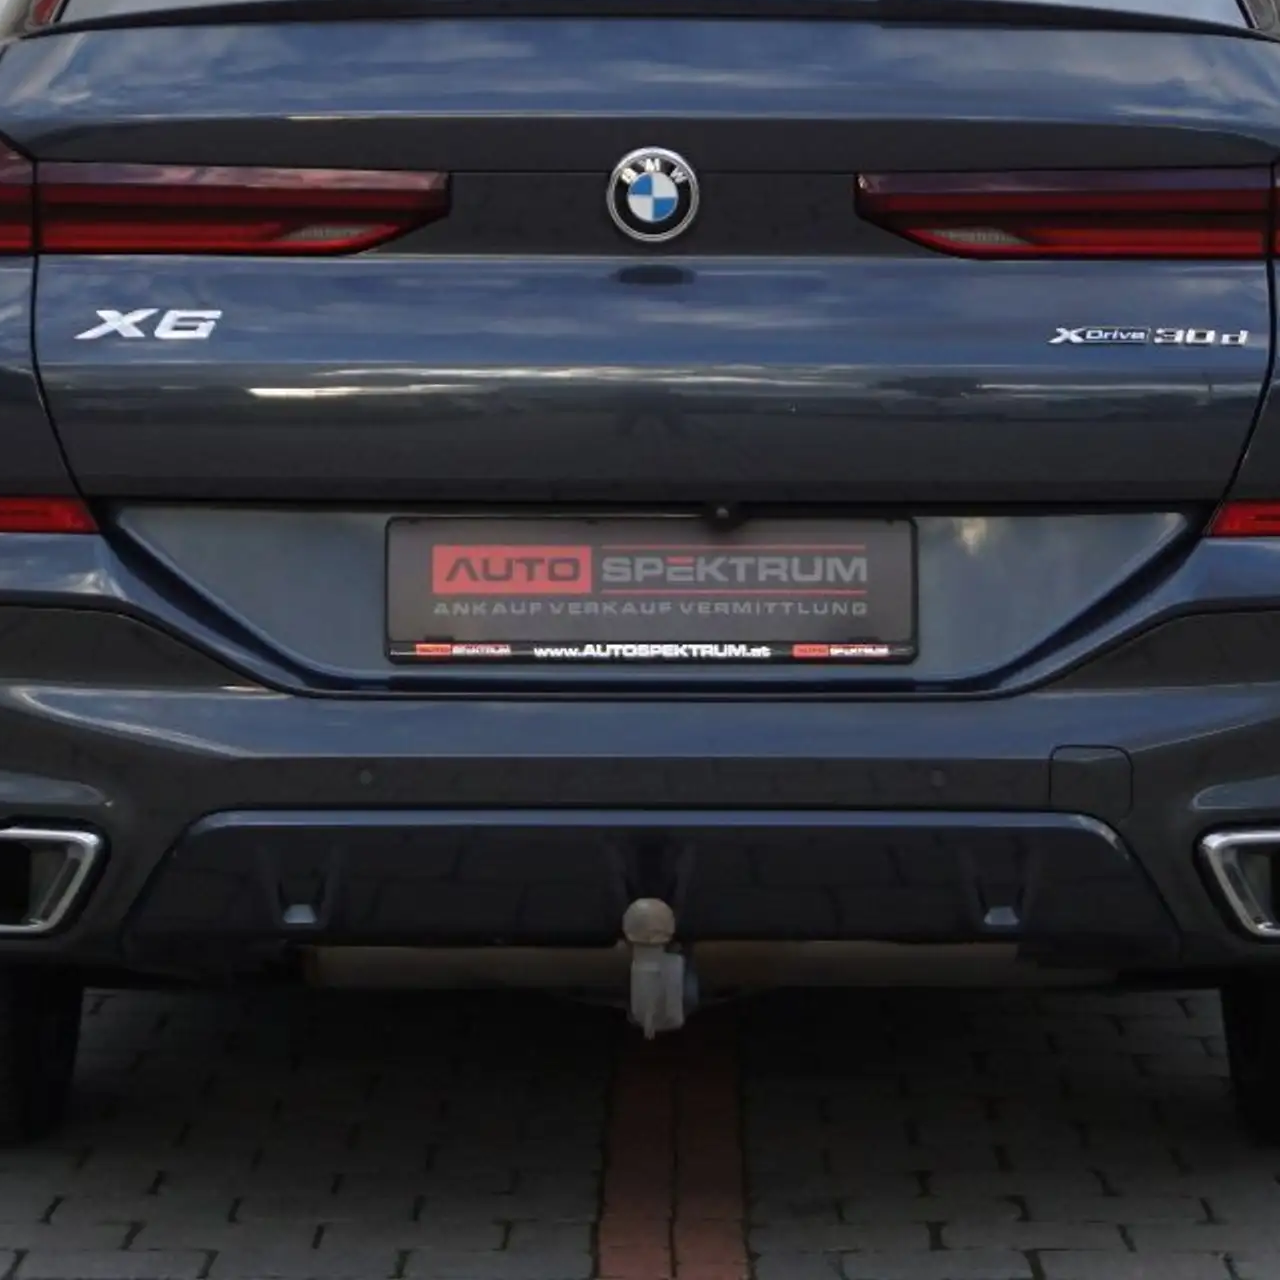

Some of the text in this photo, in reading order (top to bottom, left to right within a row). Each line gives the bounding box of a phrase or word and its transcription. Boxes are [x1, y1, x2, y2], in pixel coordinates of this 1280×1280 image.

[621, 158, 688, 184] BMW
[73, 308, 222, 339] X6
[444, 557, 868, 582] AUTO SPEKTRUM
[434, 602, 868, 615] ANKAUF VERKAUF VERMITTLUNG
[533, 644, 771, 657] www.AUTOSPEKTRUM.at
